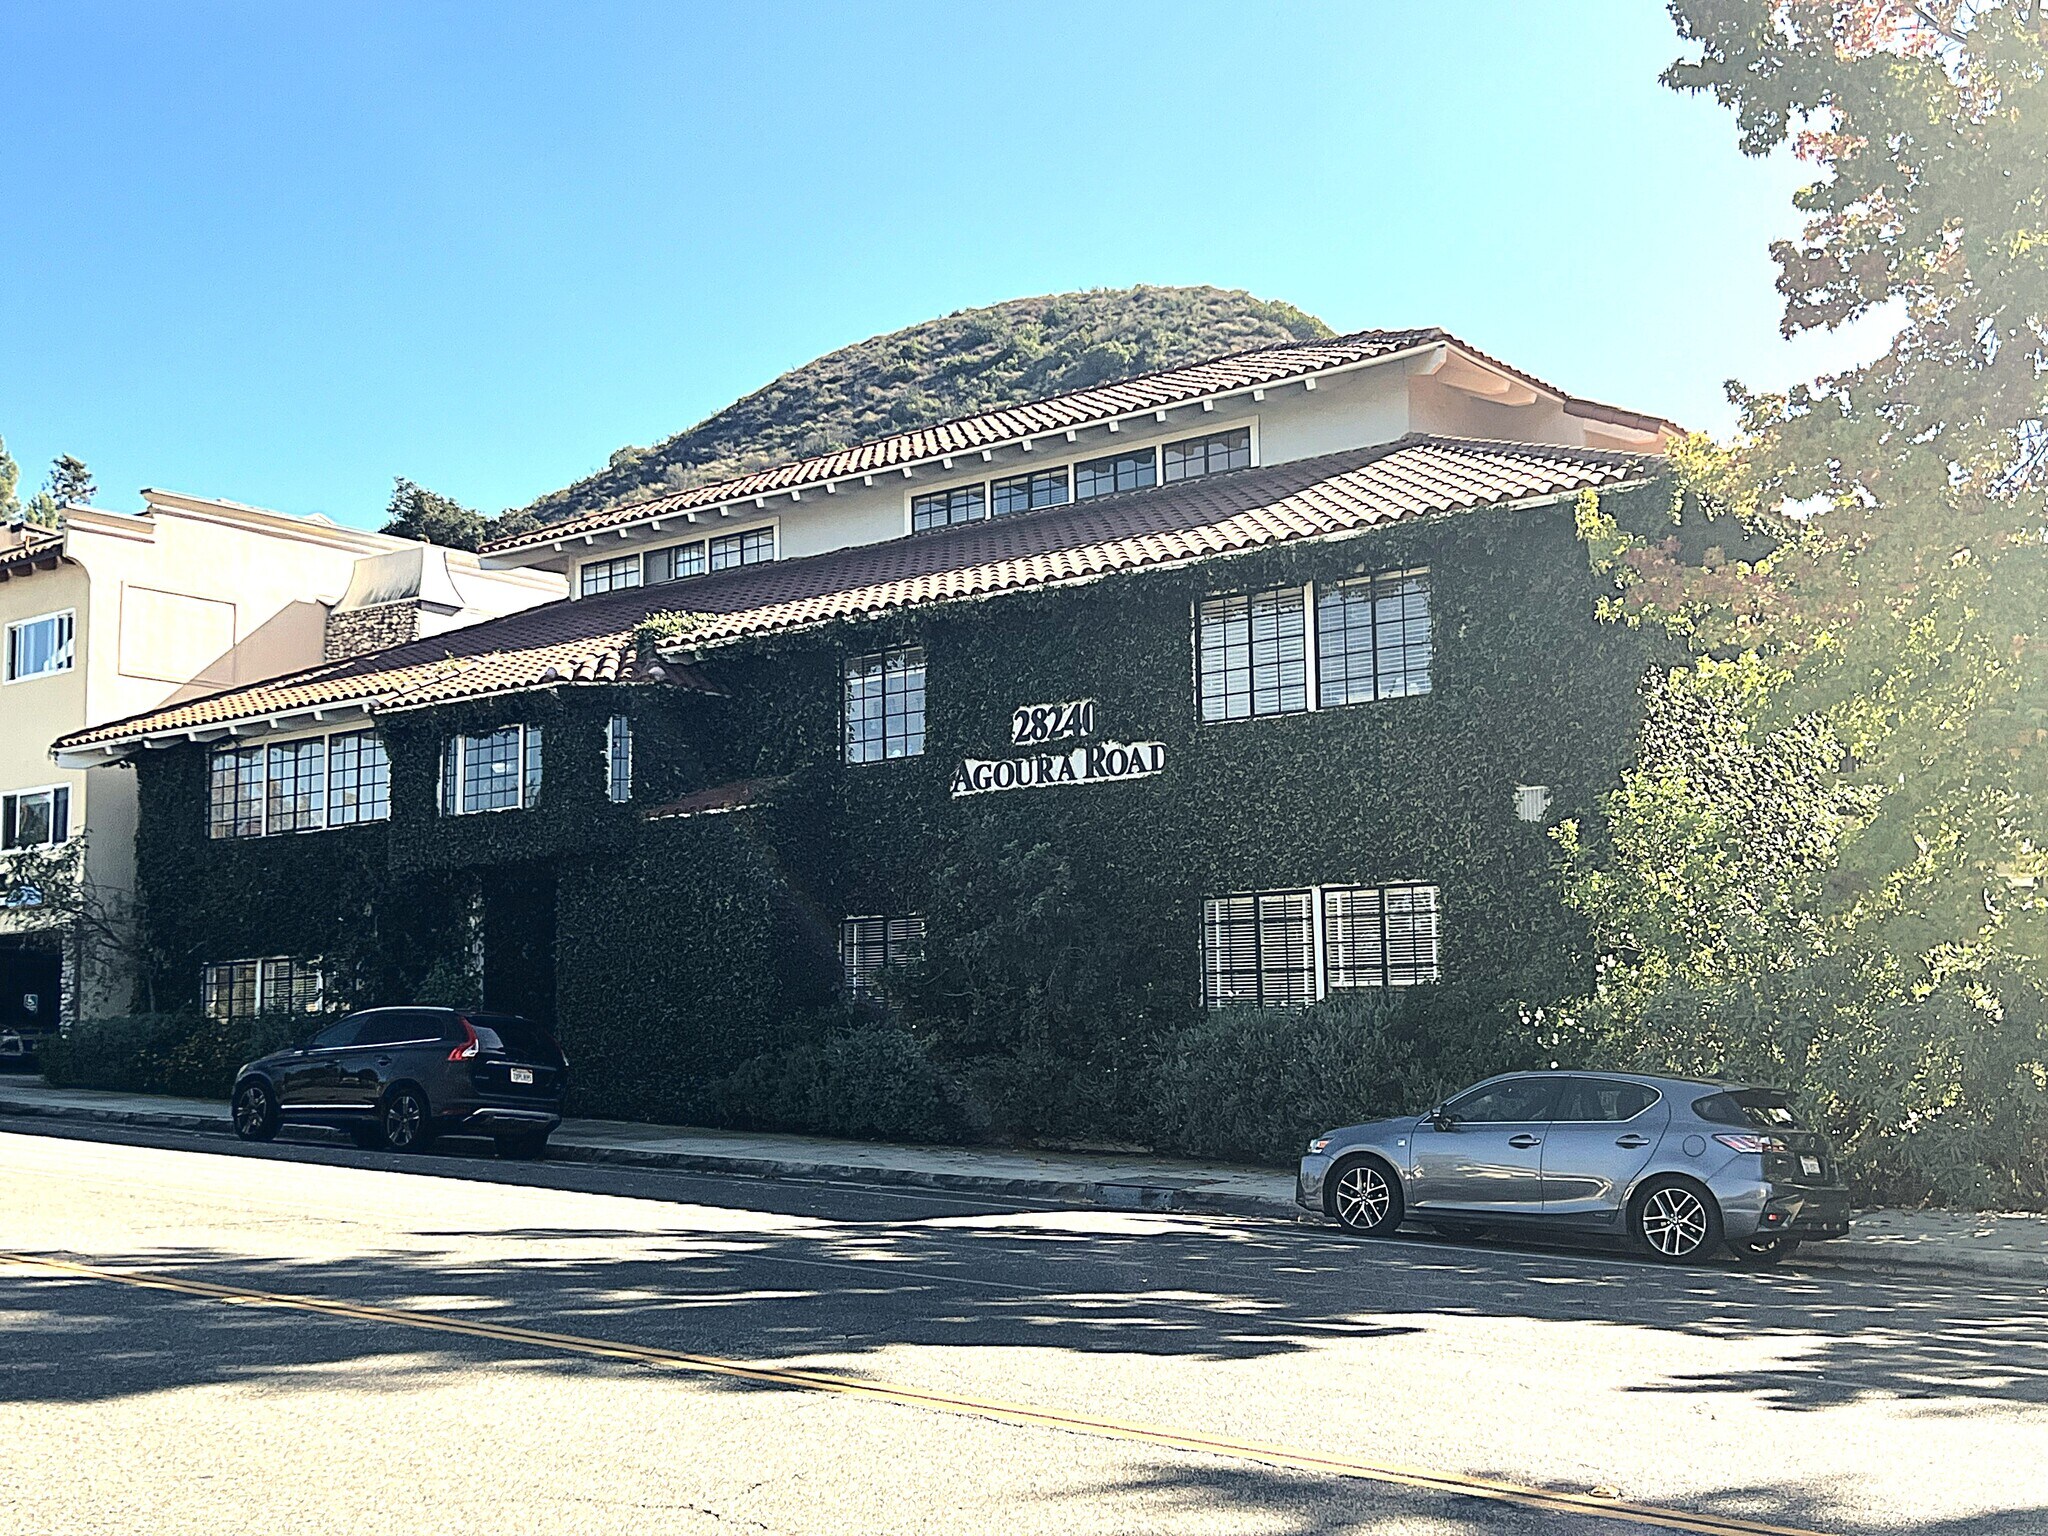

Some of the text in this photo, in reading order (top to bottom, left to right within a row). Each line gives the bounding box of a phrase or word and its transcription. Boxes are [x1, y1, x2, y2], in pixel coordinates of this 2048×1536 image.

[1013, 701, 1095, 743] 28240
[951, 744, 1167, 793] AGOURA ROAD
